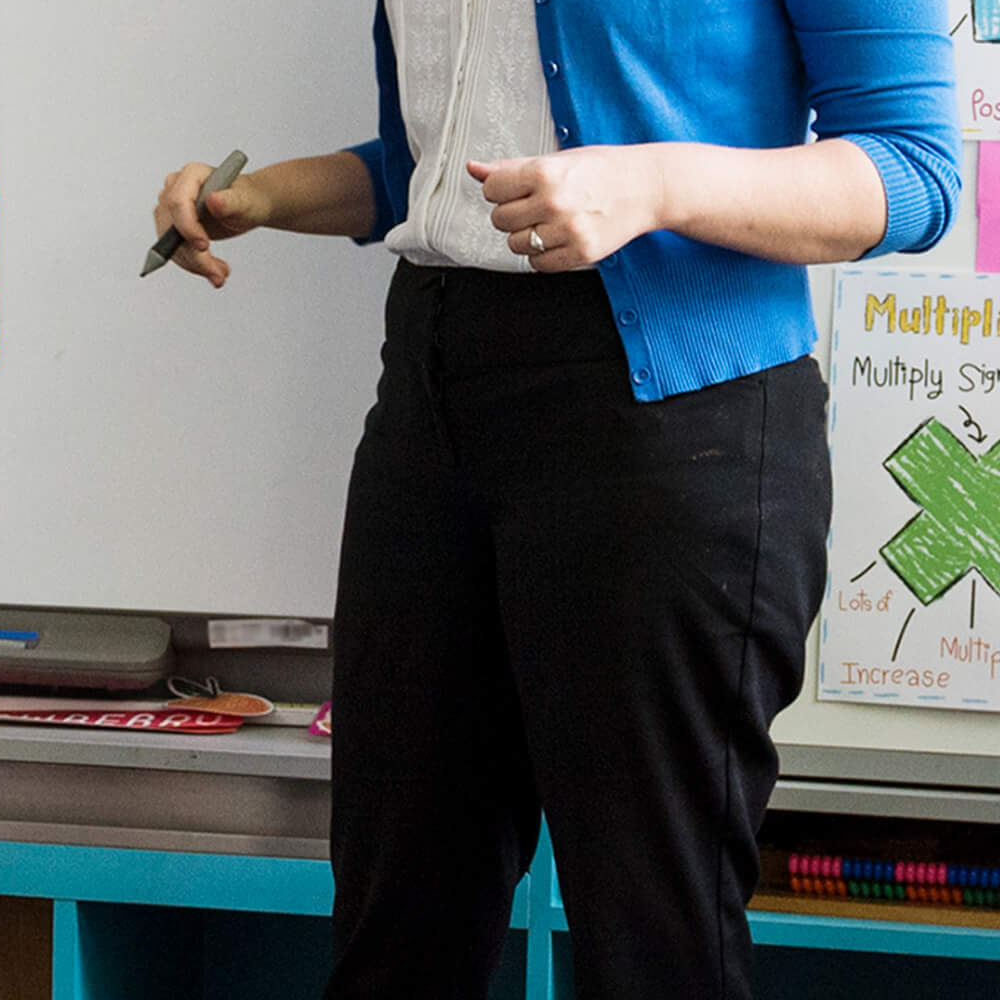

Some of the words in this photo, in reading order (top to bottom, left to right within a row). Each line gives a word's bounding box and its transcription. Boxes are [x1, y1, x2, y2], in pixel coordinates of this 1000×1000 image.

[852, 355, 943, 401] Multiply
[838, 590, 873, 612] Lots
[876, 589, 893, 612] of
[840, 661, 951, 688] Increase
